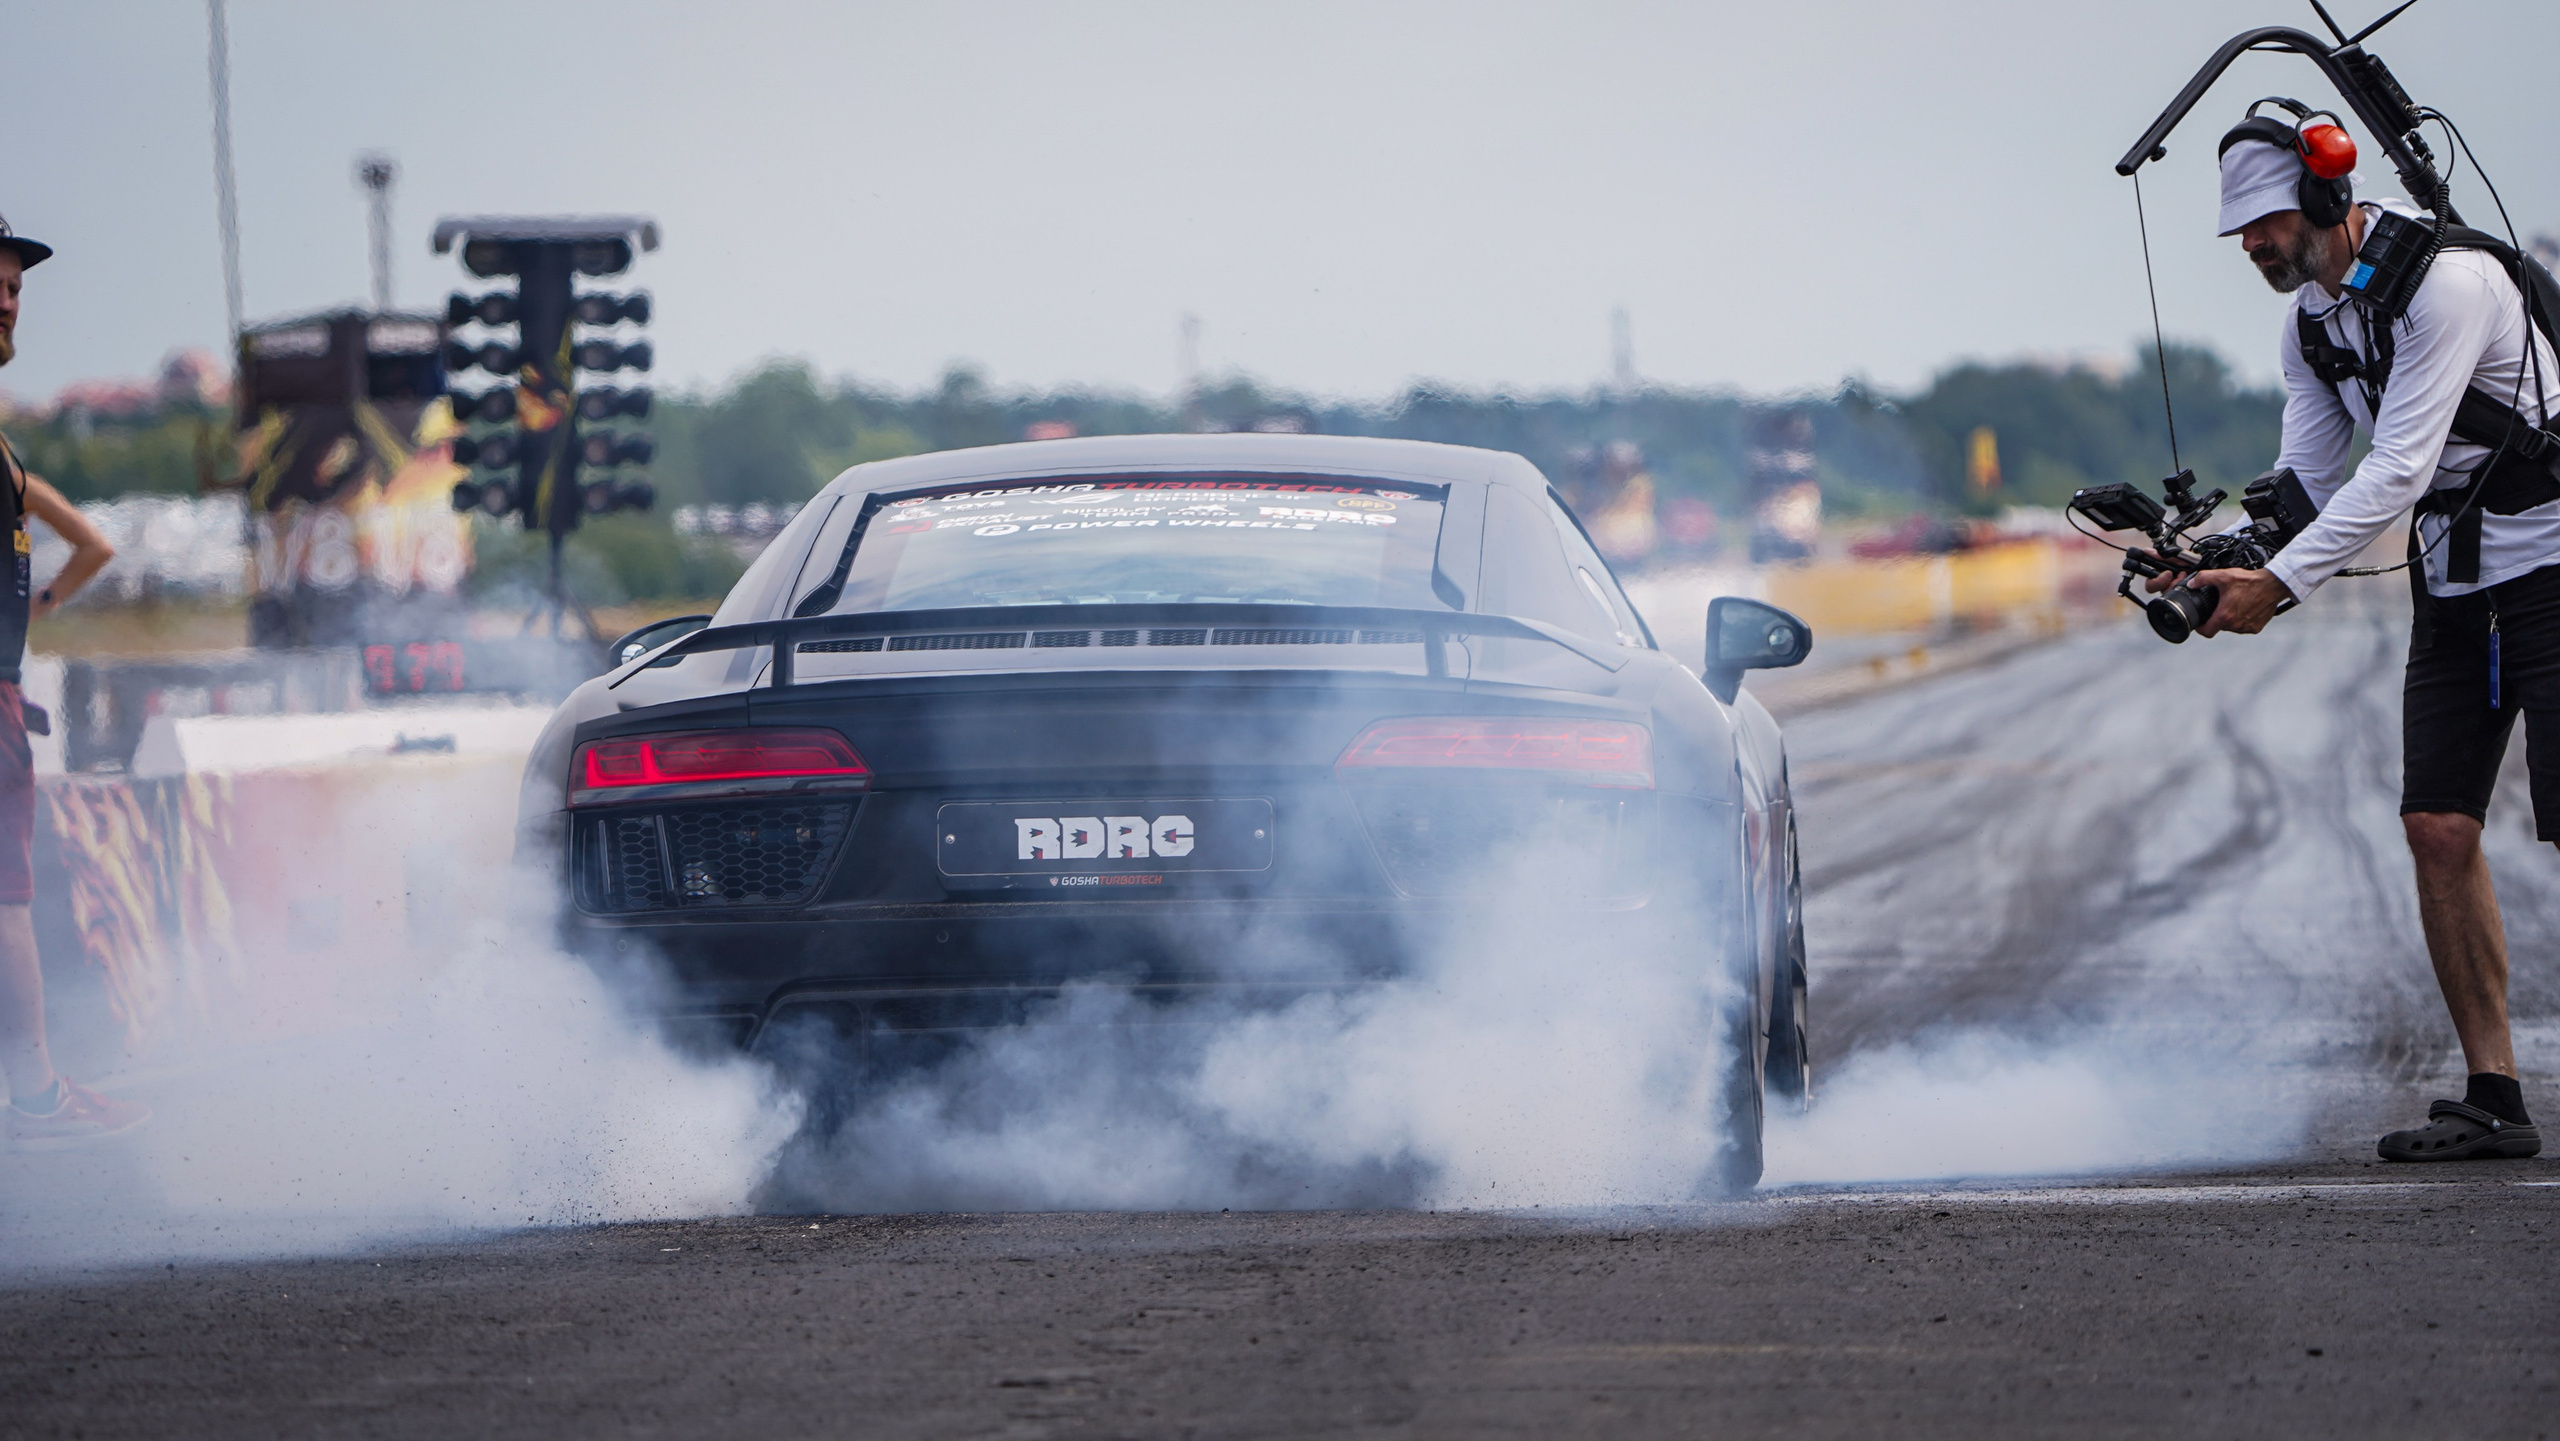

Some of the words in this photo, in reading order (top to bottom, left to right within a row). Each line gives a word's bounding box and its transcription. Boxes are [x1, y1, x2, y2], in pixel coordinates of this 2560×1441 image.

[1062, 506, 1167, 515] NIKOLAY
[1027, 519, 1160, 531] POWER
[1168, 519, 1318, 531] WHEELS
[1014, 815, 1195, 860] RDRC
[1061, 874, 1163, 887] GOSHATURBOTECH
